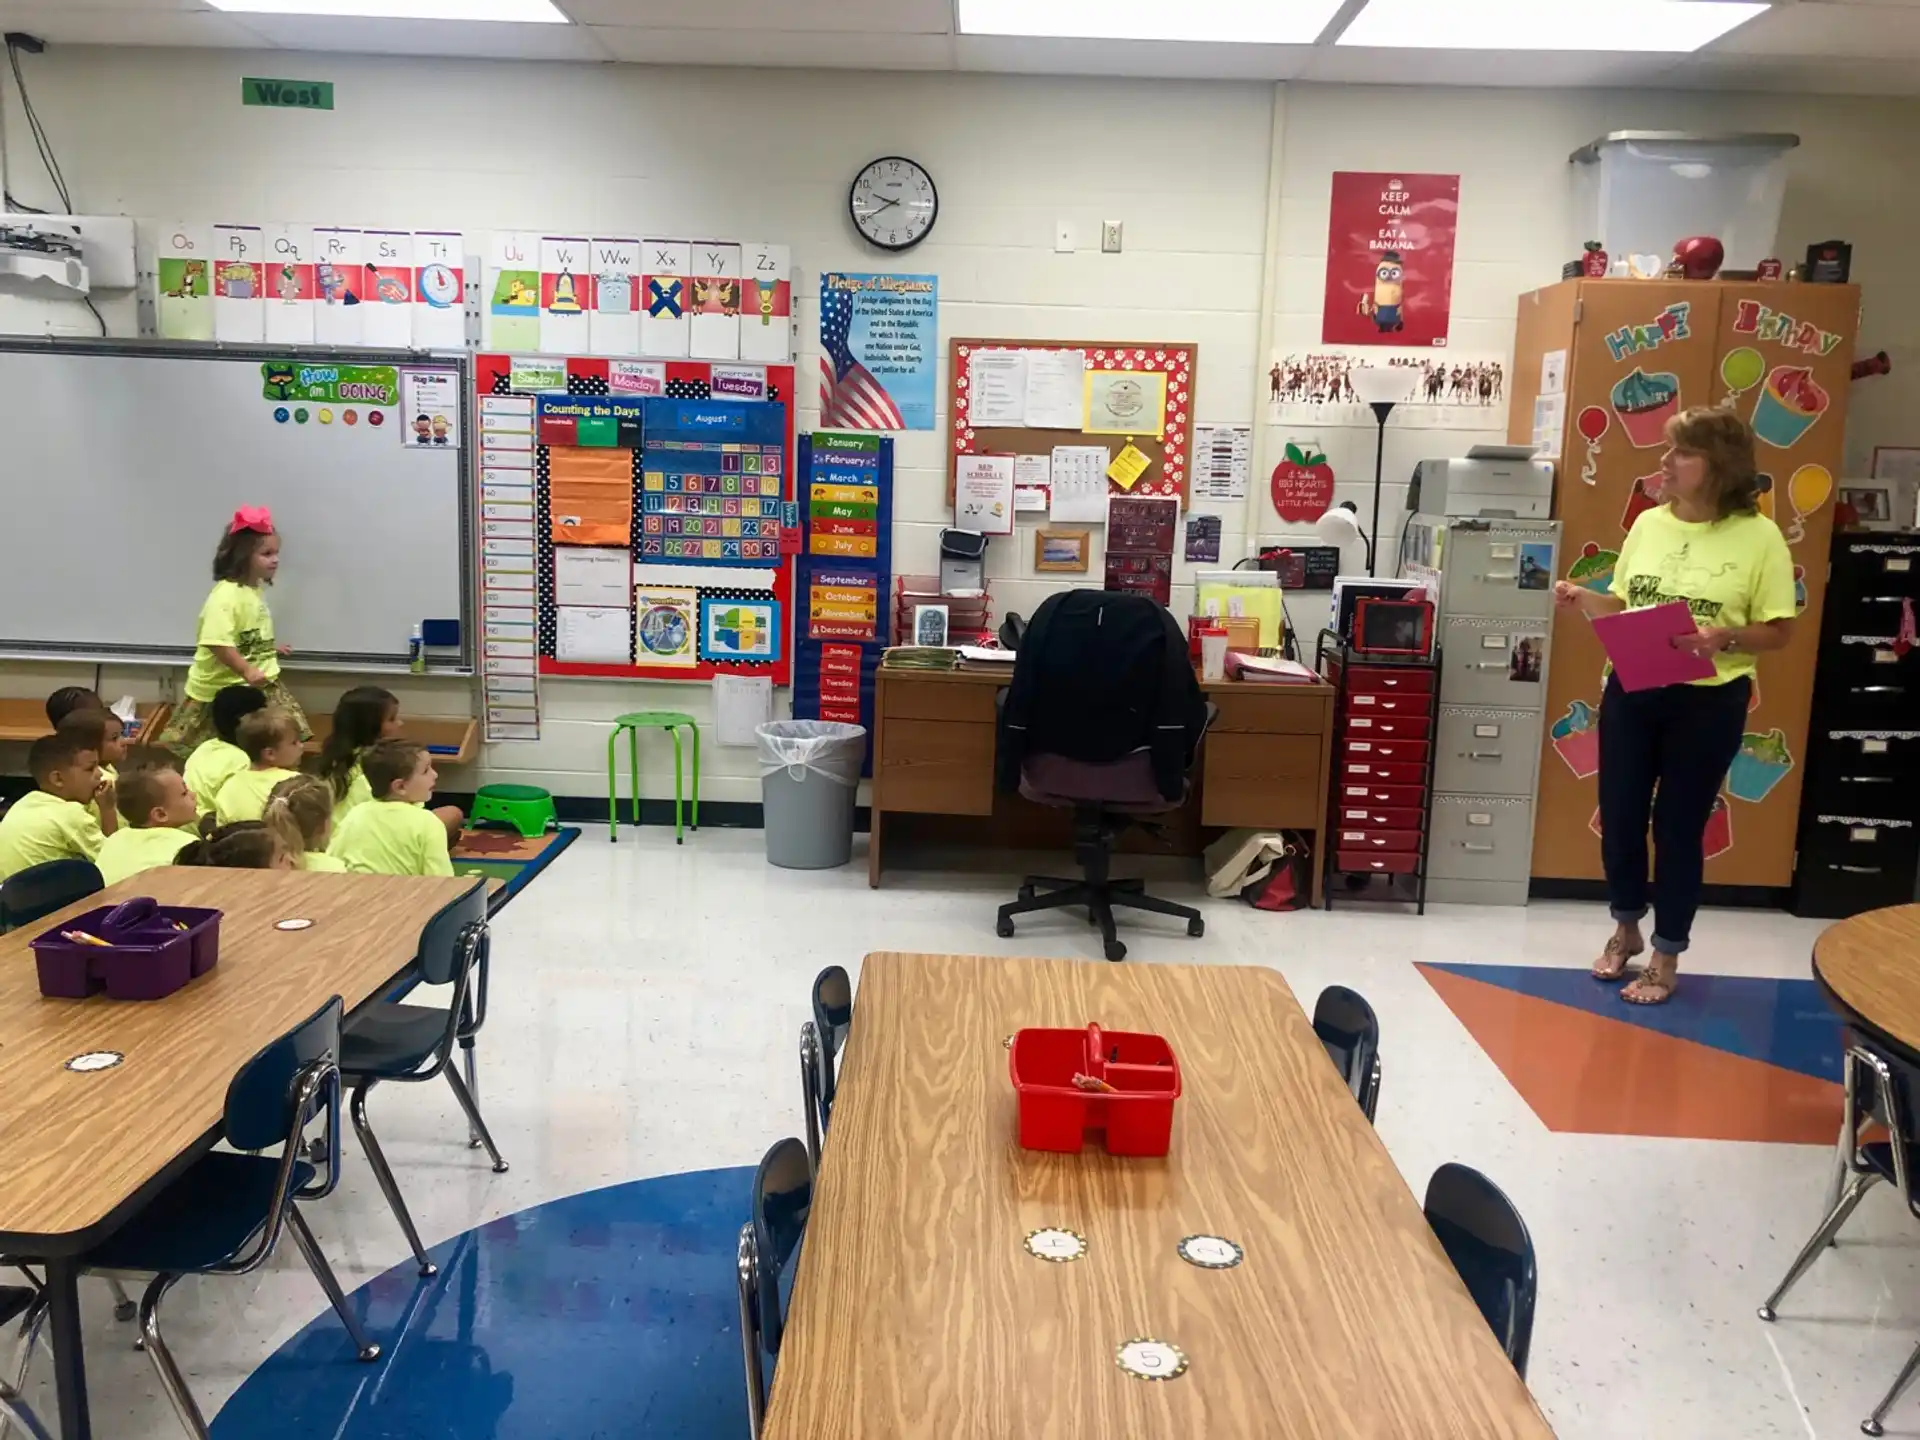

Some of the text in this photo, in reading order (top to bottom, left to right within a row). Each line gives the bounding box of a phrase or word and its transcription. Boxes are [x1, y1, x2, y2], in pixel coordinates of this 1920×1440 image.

[256, 83, 321, 106] West
[890, 163, 899, 172] 12
[921, 181, 927, 190] 2
[1381, 192, 1410, 201] KEEP
[1379, 205, 1411, 215] CALM
[890, 234, 895, 243] 6
[907, 230, 913, 239] 5
[1379, 229, 1406, 238] EAT A
[230, 236, 246, 257] Pp
[274, 238, 302, 261] Qq
[328, 238, 346, 254] Rr
[379, 242, 397, 258] Ss
[430, 242, 447, 256] Tt
[1369, 240, 1414, 250] BANANA
[504, 246, 524, 262] Uu
[556, 249, 573, 264] Vv
[600, 250, 631, 265] Ww
[656, 250, 676, 267] Xx
[706, 253, 725, 273] Yy
[756, 255, 776, 271] Zz
[828, 275, 932, 295] Pledge of Allegiance
[618, 363, 643, 374] Today
[713, 368, 753, 378] Tomorrow
[518, 372, 555, 386] Sunday
[614, 375, 655, 393] Monday
[718, 378, 759, 396] Tuesday
[544, 403, 640, 418] Counting the Days
[696, 415, 728, 424] August
[827, 438, 863, 450] January
[748, 458, 756, 470] 2
[767, 458, 776, 472] 3
[825, 455, 865, 466] February
[669, 476, 678, 489] 5
[689, 476, 697, 489] 6
[709, 478, 716, 490] 7
[830, 473, 857, 482] March
[727, 478, 735, 491] 8
[746, 479, 755, 492] 9
[650, 498, 658, 510] 11
[669, 498, 679, 511] 12
[687, 499, 699, 512] 13
[706, 499, 718, 513] 14
[725, 500, 736, 513] 15
[764, 501, 775, 514] 17
[833, 507, 852, 517] May
[648, 518, 659, 530] 18
[668, 520, 679, 532] 19
[686, 518, 700, 532] 20
[706, 520, 718, 533] 21
[743, 521, 758, 534] 23
[762, 522, 778, 535] 24
[832, 524, 854, 533] June
[644, 540, 660, 553] 25
[666, 541, 682, 554] 26
[684, 542, 700, 554] 27
[724, 542, 739, 555] 29
[743, 543, 759, 555] 30
[764, 543, 775, 555] 31
[834, 540, 852, 551] July
[820, 575, 868, 586] September
[826, 592, 862, 601] October
[822, 608, 865, 618] November
[820, 626, 864, 635] December
[828, 664, 852, 672] Monday
[824, 711, 854, 720] Thursday
